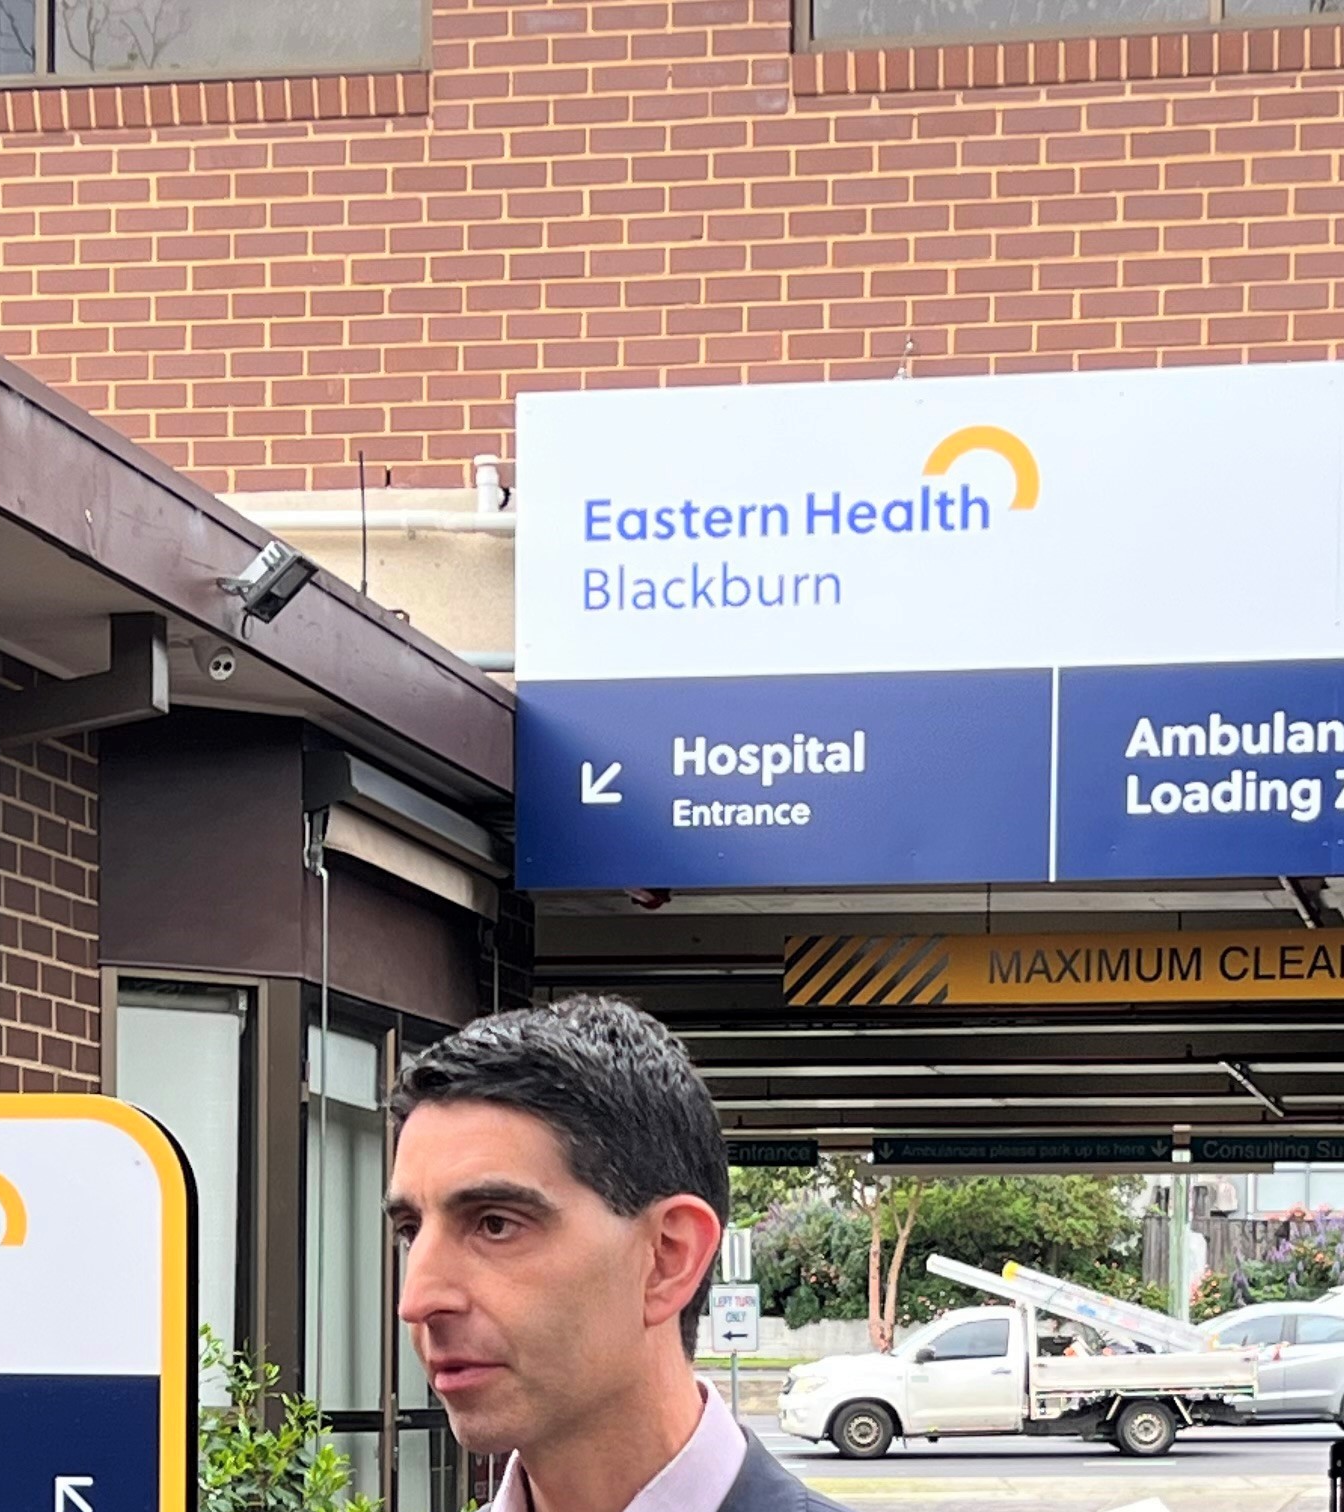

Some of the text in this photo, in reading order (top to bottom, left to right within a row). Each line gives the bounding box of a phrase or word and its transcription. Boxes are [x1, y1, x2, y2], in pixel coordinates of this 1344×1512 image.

[584, 486, 990, 541] Eastern Health
[582, 562, 843, 611] Blackburn
[671, 730, 866, 788] Hospital
[671, 797, 811, 828] Entrance
[1125, 766, 1324, 822] Loading
[986, 945, 1202, 985] MAXIMUM
[1202, 1138, 1309, 1161] Consulting
